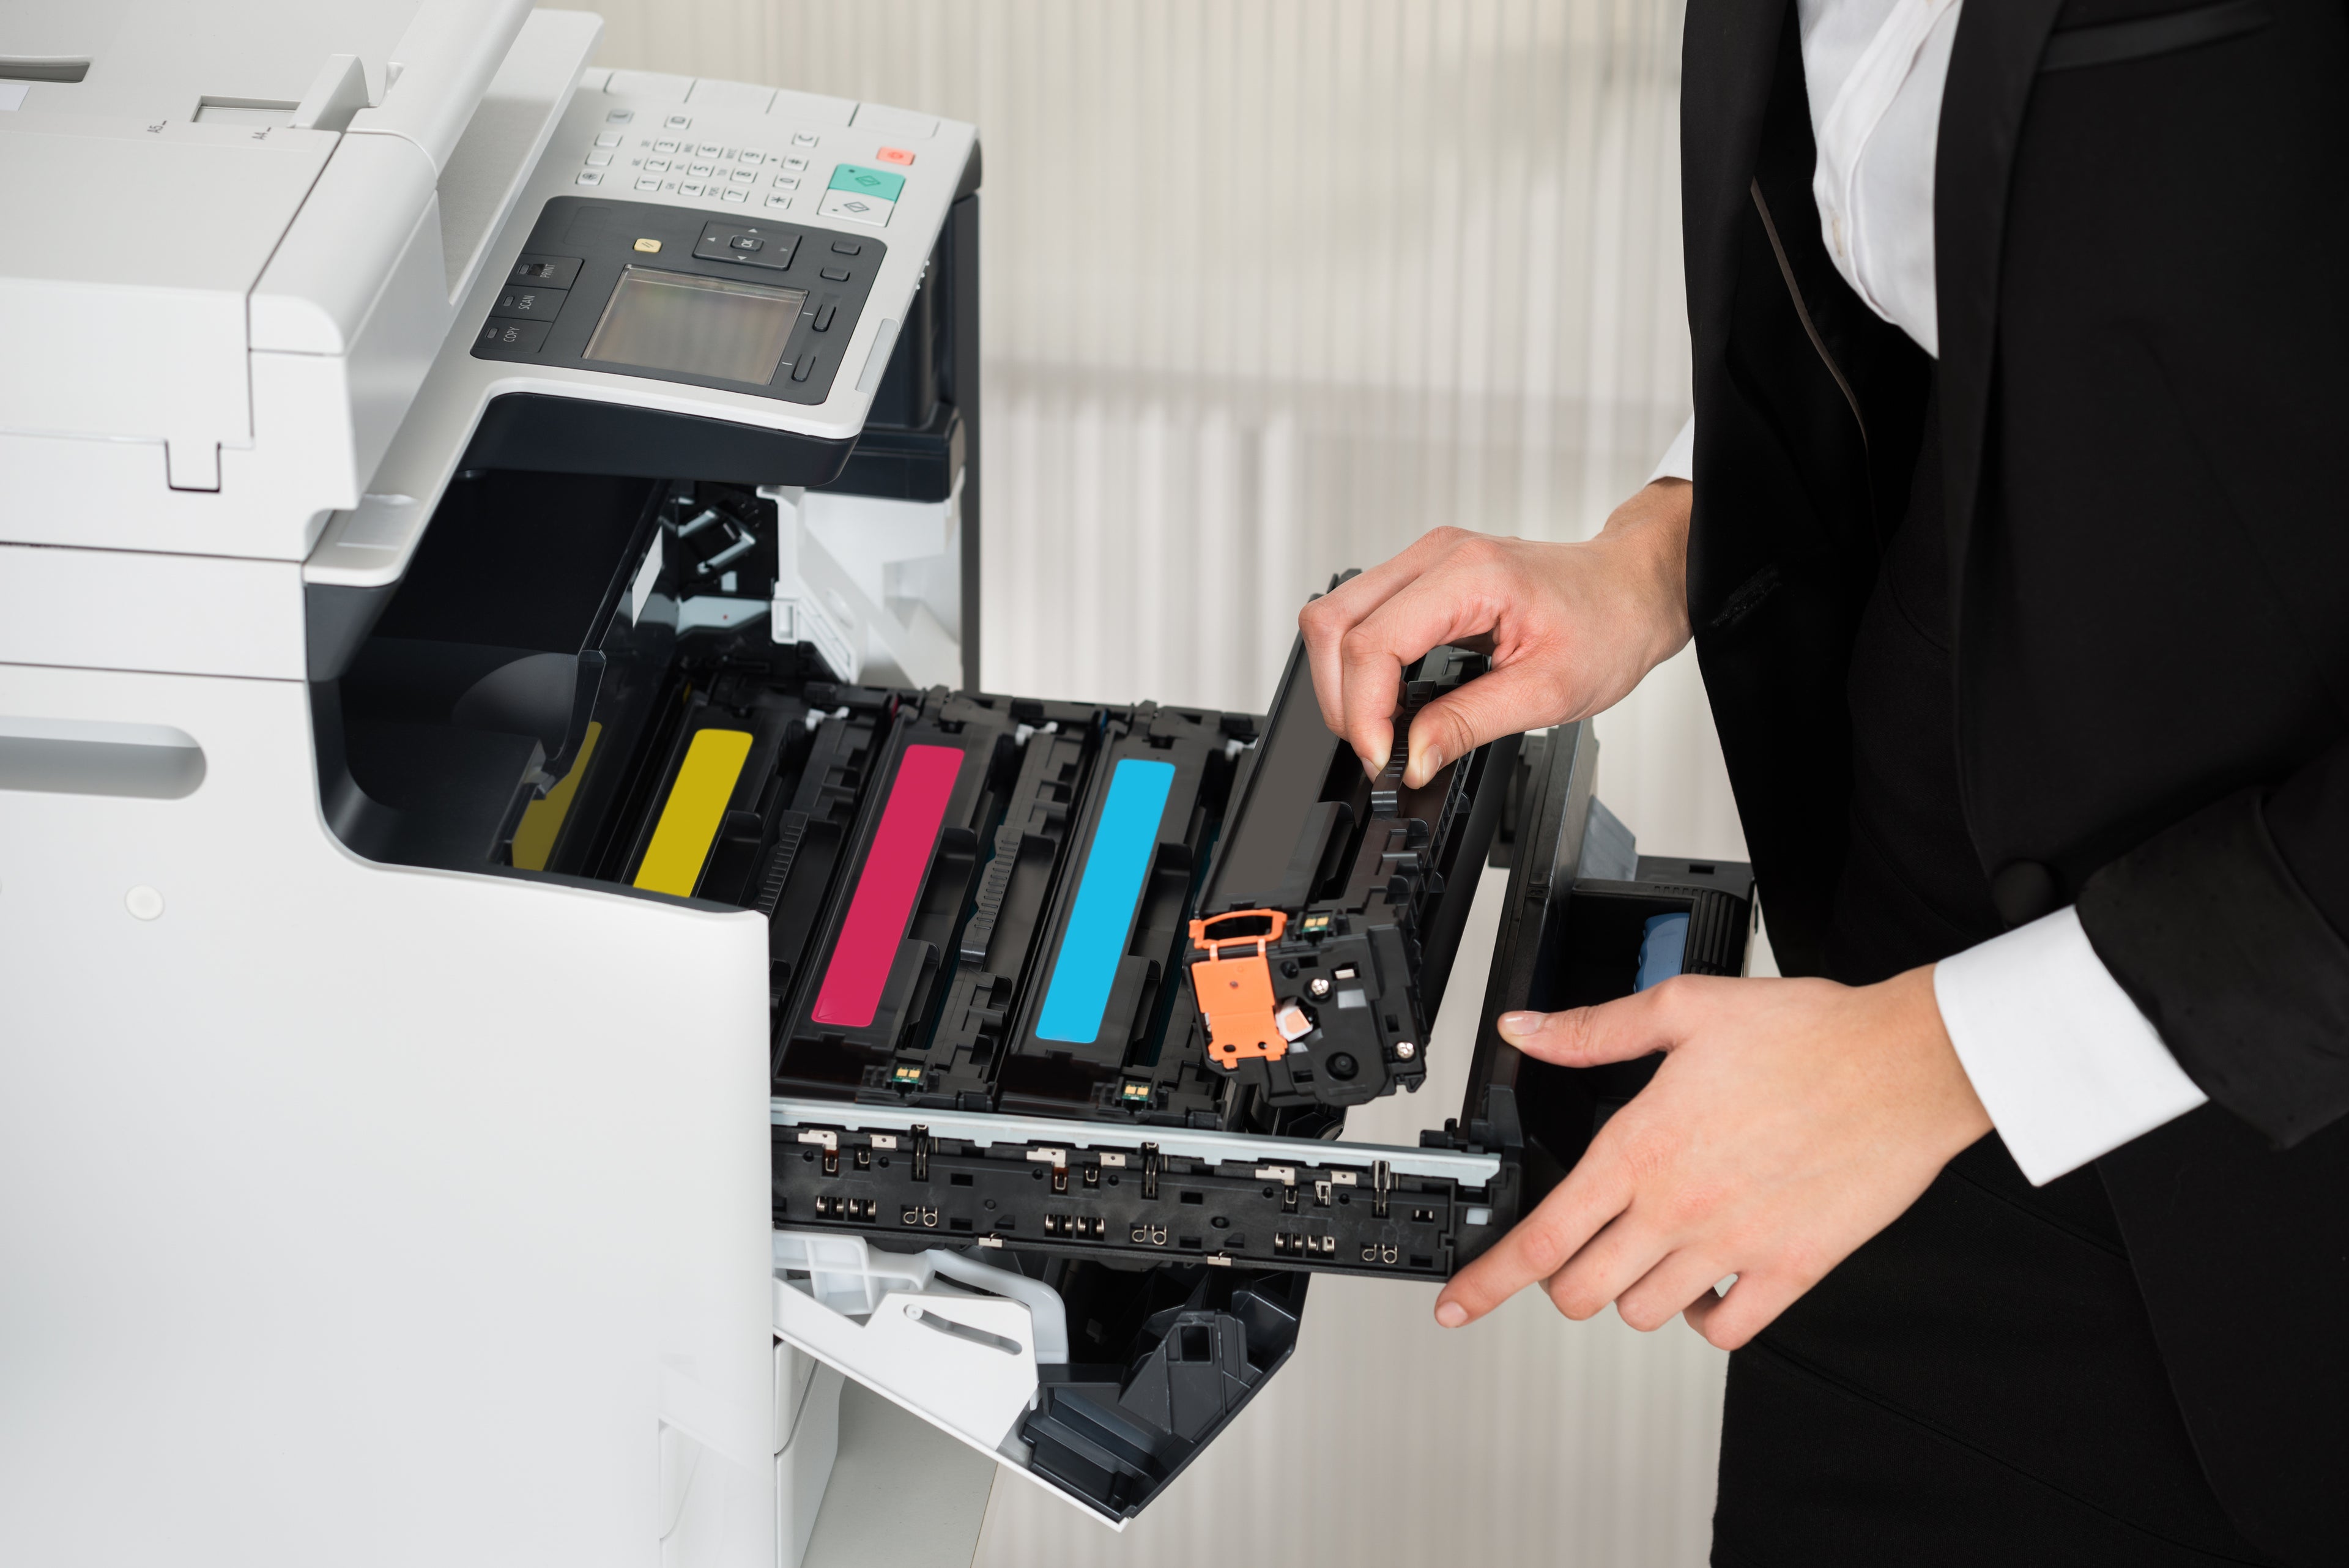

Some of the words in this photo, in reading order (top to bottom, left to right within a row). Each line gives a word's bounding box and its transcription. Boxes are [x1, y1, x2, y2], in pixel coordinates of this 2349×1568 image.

[741, 239, 754, 248] OK
[540, 264, 555, 278] PRINT
[518, 295, 535, 310] SCAN
[503, 327, 520, 343] COPY
